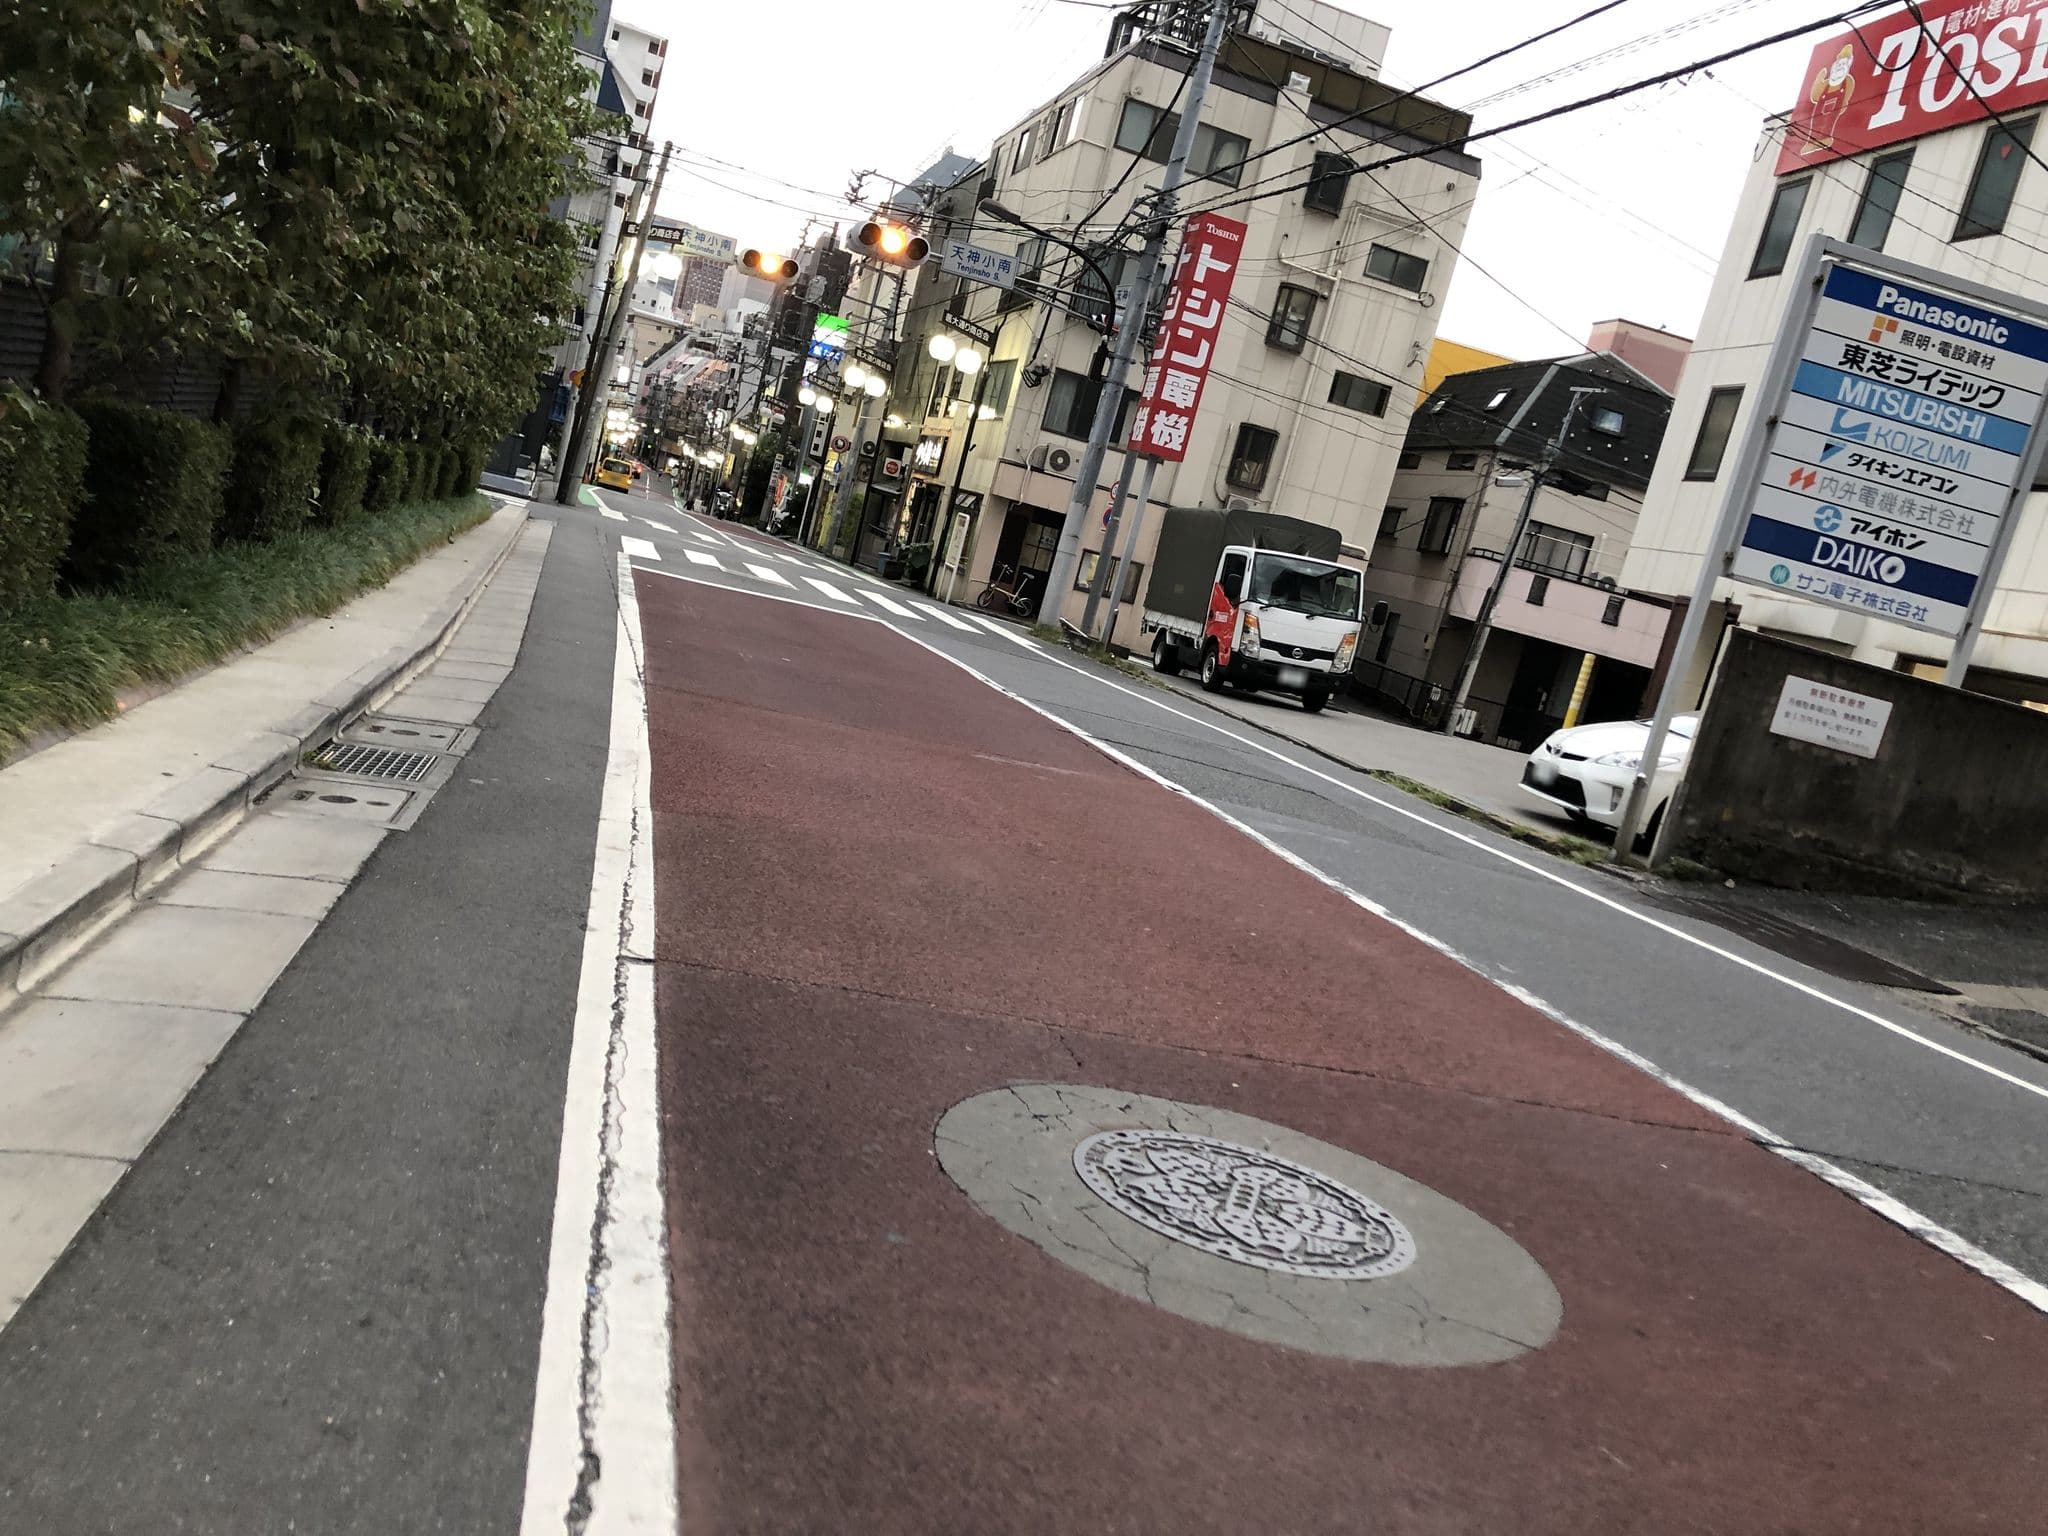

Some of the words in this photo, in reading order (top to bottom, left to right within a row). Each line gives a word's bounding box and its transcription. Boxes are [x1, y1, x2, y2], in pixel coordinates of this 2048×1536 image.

[683, 228, 732, 251] 天神小南
[1206, 223, 1240, 242] TOSHIN
[950, 245, 1013, 274] 天神小南
[957, 262, 991, 278] Tenjinsho
[1876, 285, 2009, 344] Panasonic
[1151, 243, 1233, 451] トシン電機
[1899, 329, 1996, 371] 照明・電設資材
[1838, 343, 2006, 409] 東芝ライテック
[1837, 376, 1987, 441] MITSUBISHI
[1873, 426, 1972, 470] KOIZUMI
[1847, 452, 1959, 495] ダイキンエアコン
[1818, 476, 1975, 536] 内外電機株式会社
[1850, 516, 1928, 551] アイホン
[1812, 535, 1906, 584] DAIKO
[1796, 573, 1929, 623] サン電子株式会社
